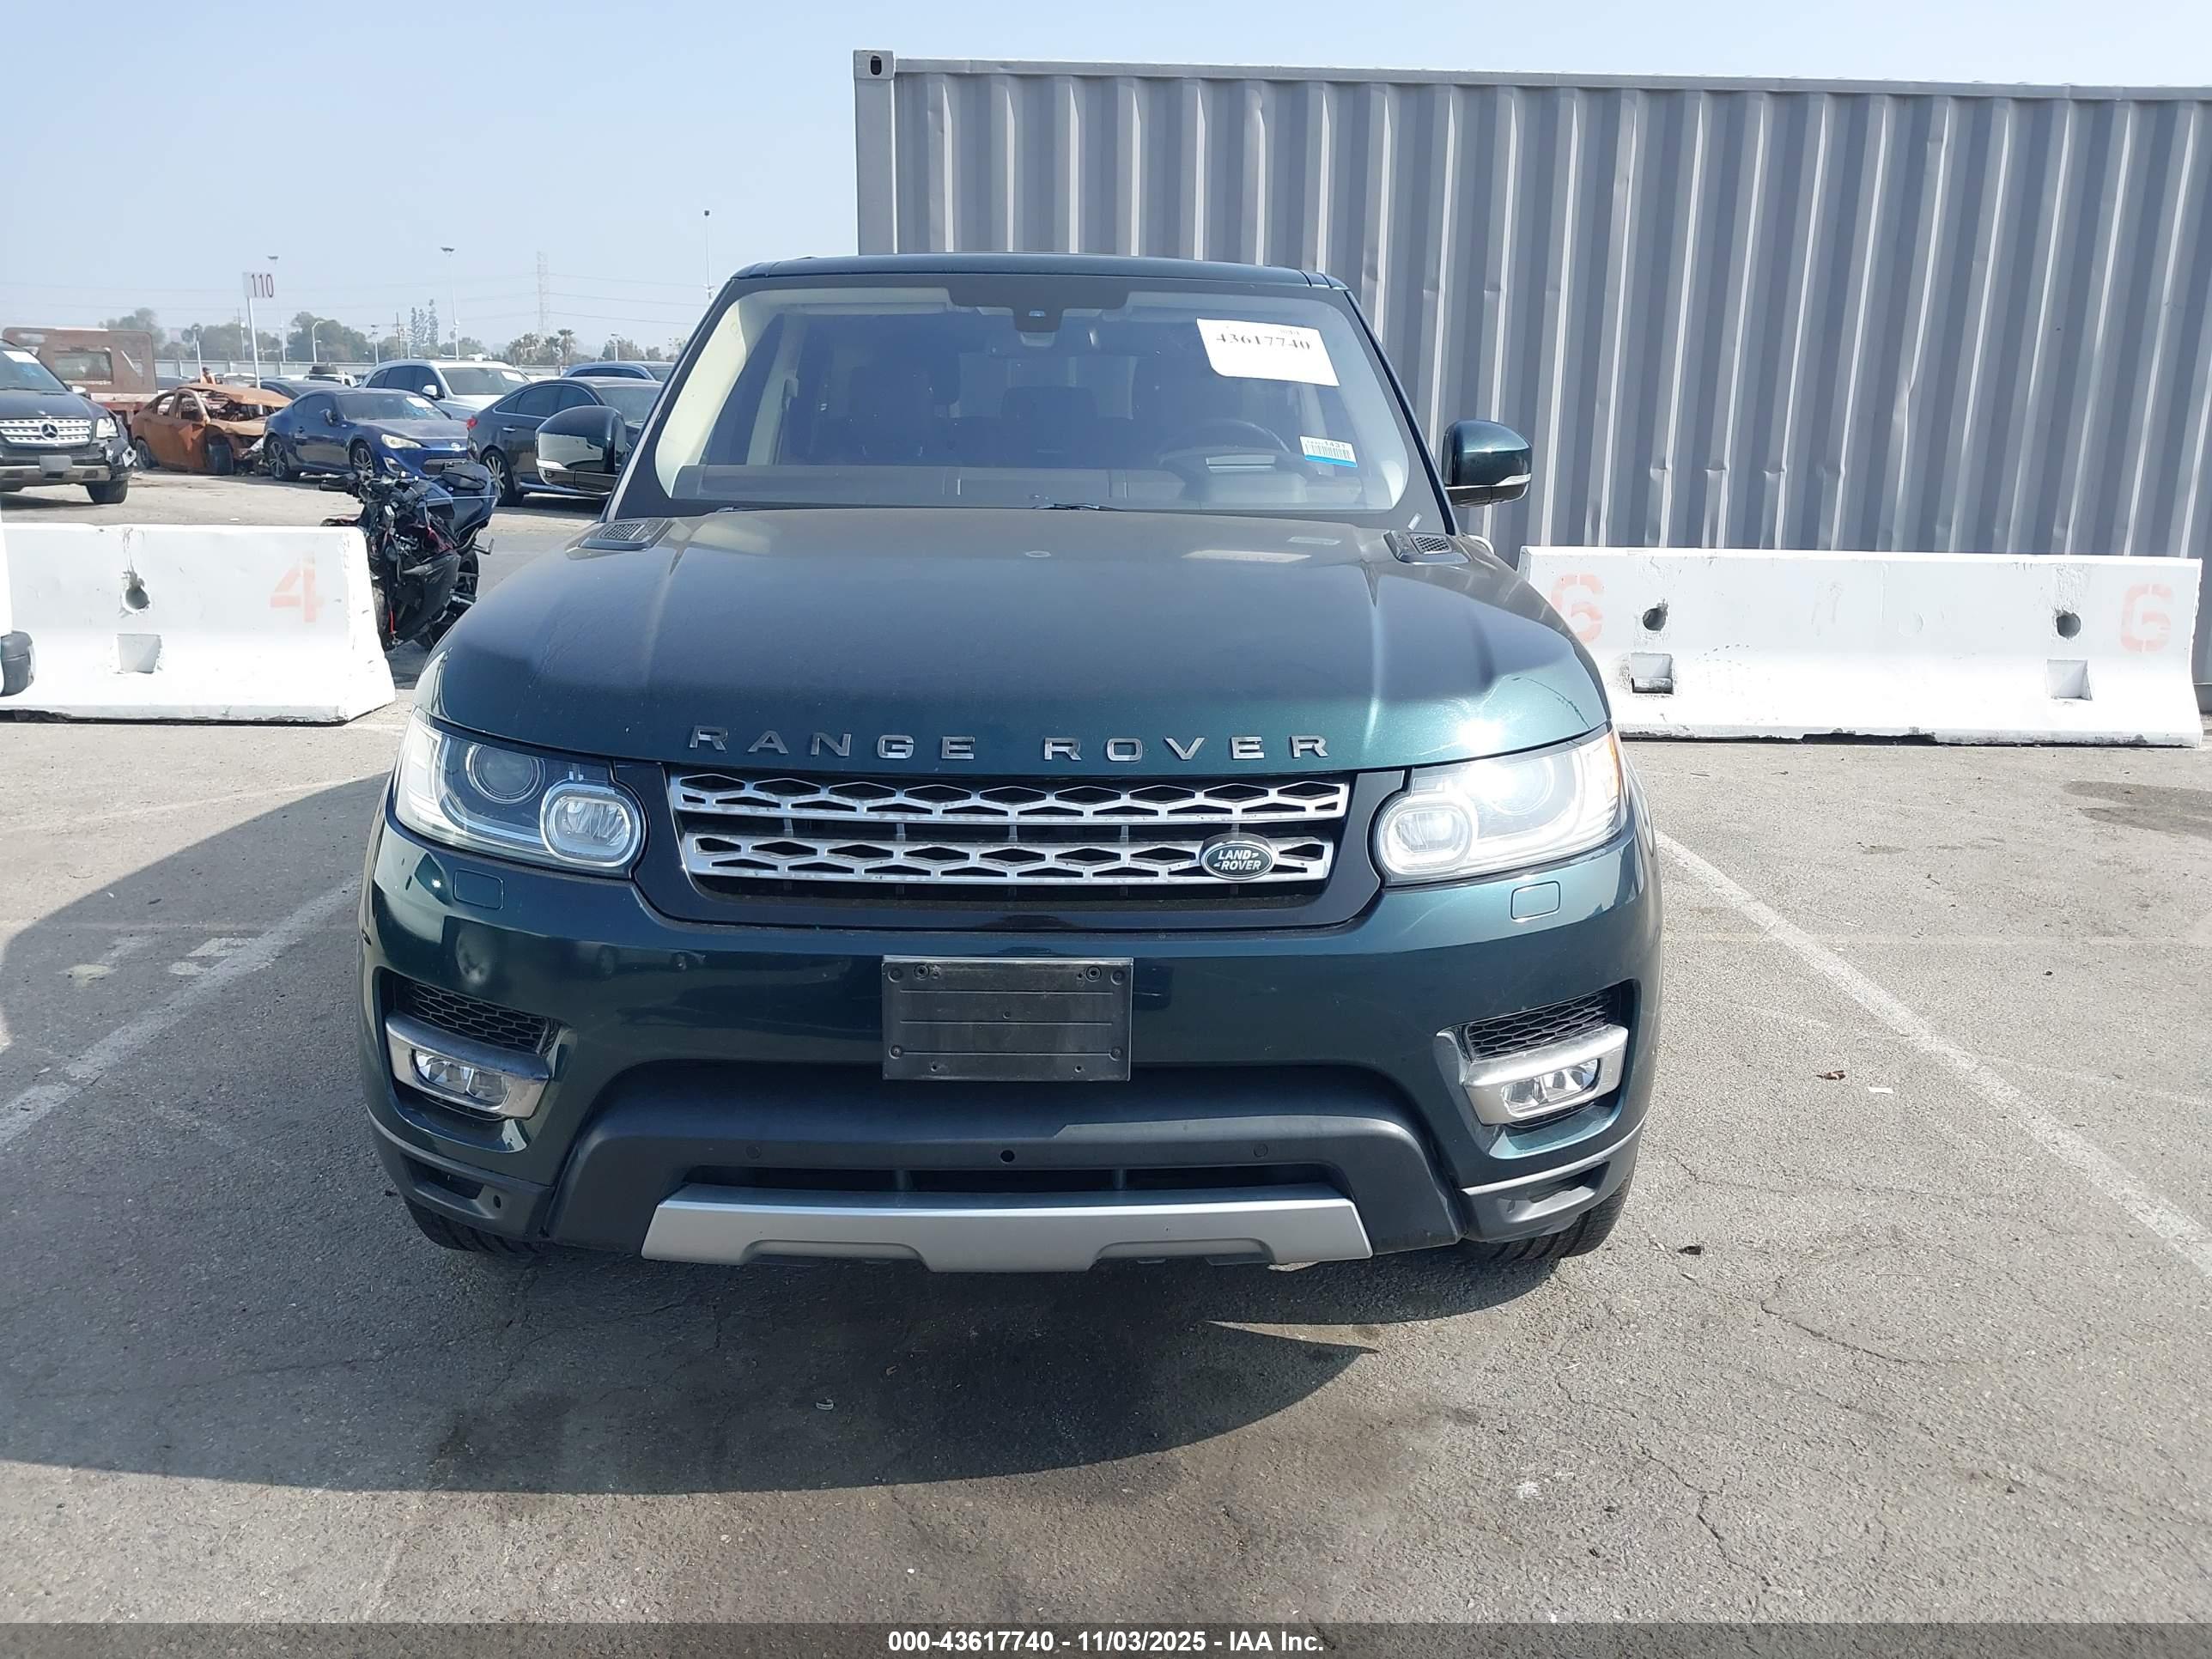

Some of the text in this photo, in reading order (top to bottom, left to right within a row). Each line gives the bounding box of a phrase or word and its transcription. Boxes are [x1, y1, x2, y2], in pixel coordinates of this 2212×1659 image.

[251, 273, 275, 298] 110
[1216, 333, 1311, 350] 43617740
[270, 553, 324, 623] 4
[1550, 572, 1604, 644] 6
[690, 725, 1329, 763] RANGE ROVER
[1218, 849, 1252, 860] LAND
[1220, 860, 1261, 870] ROVER
